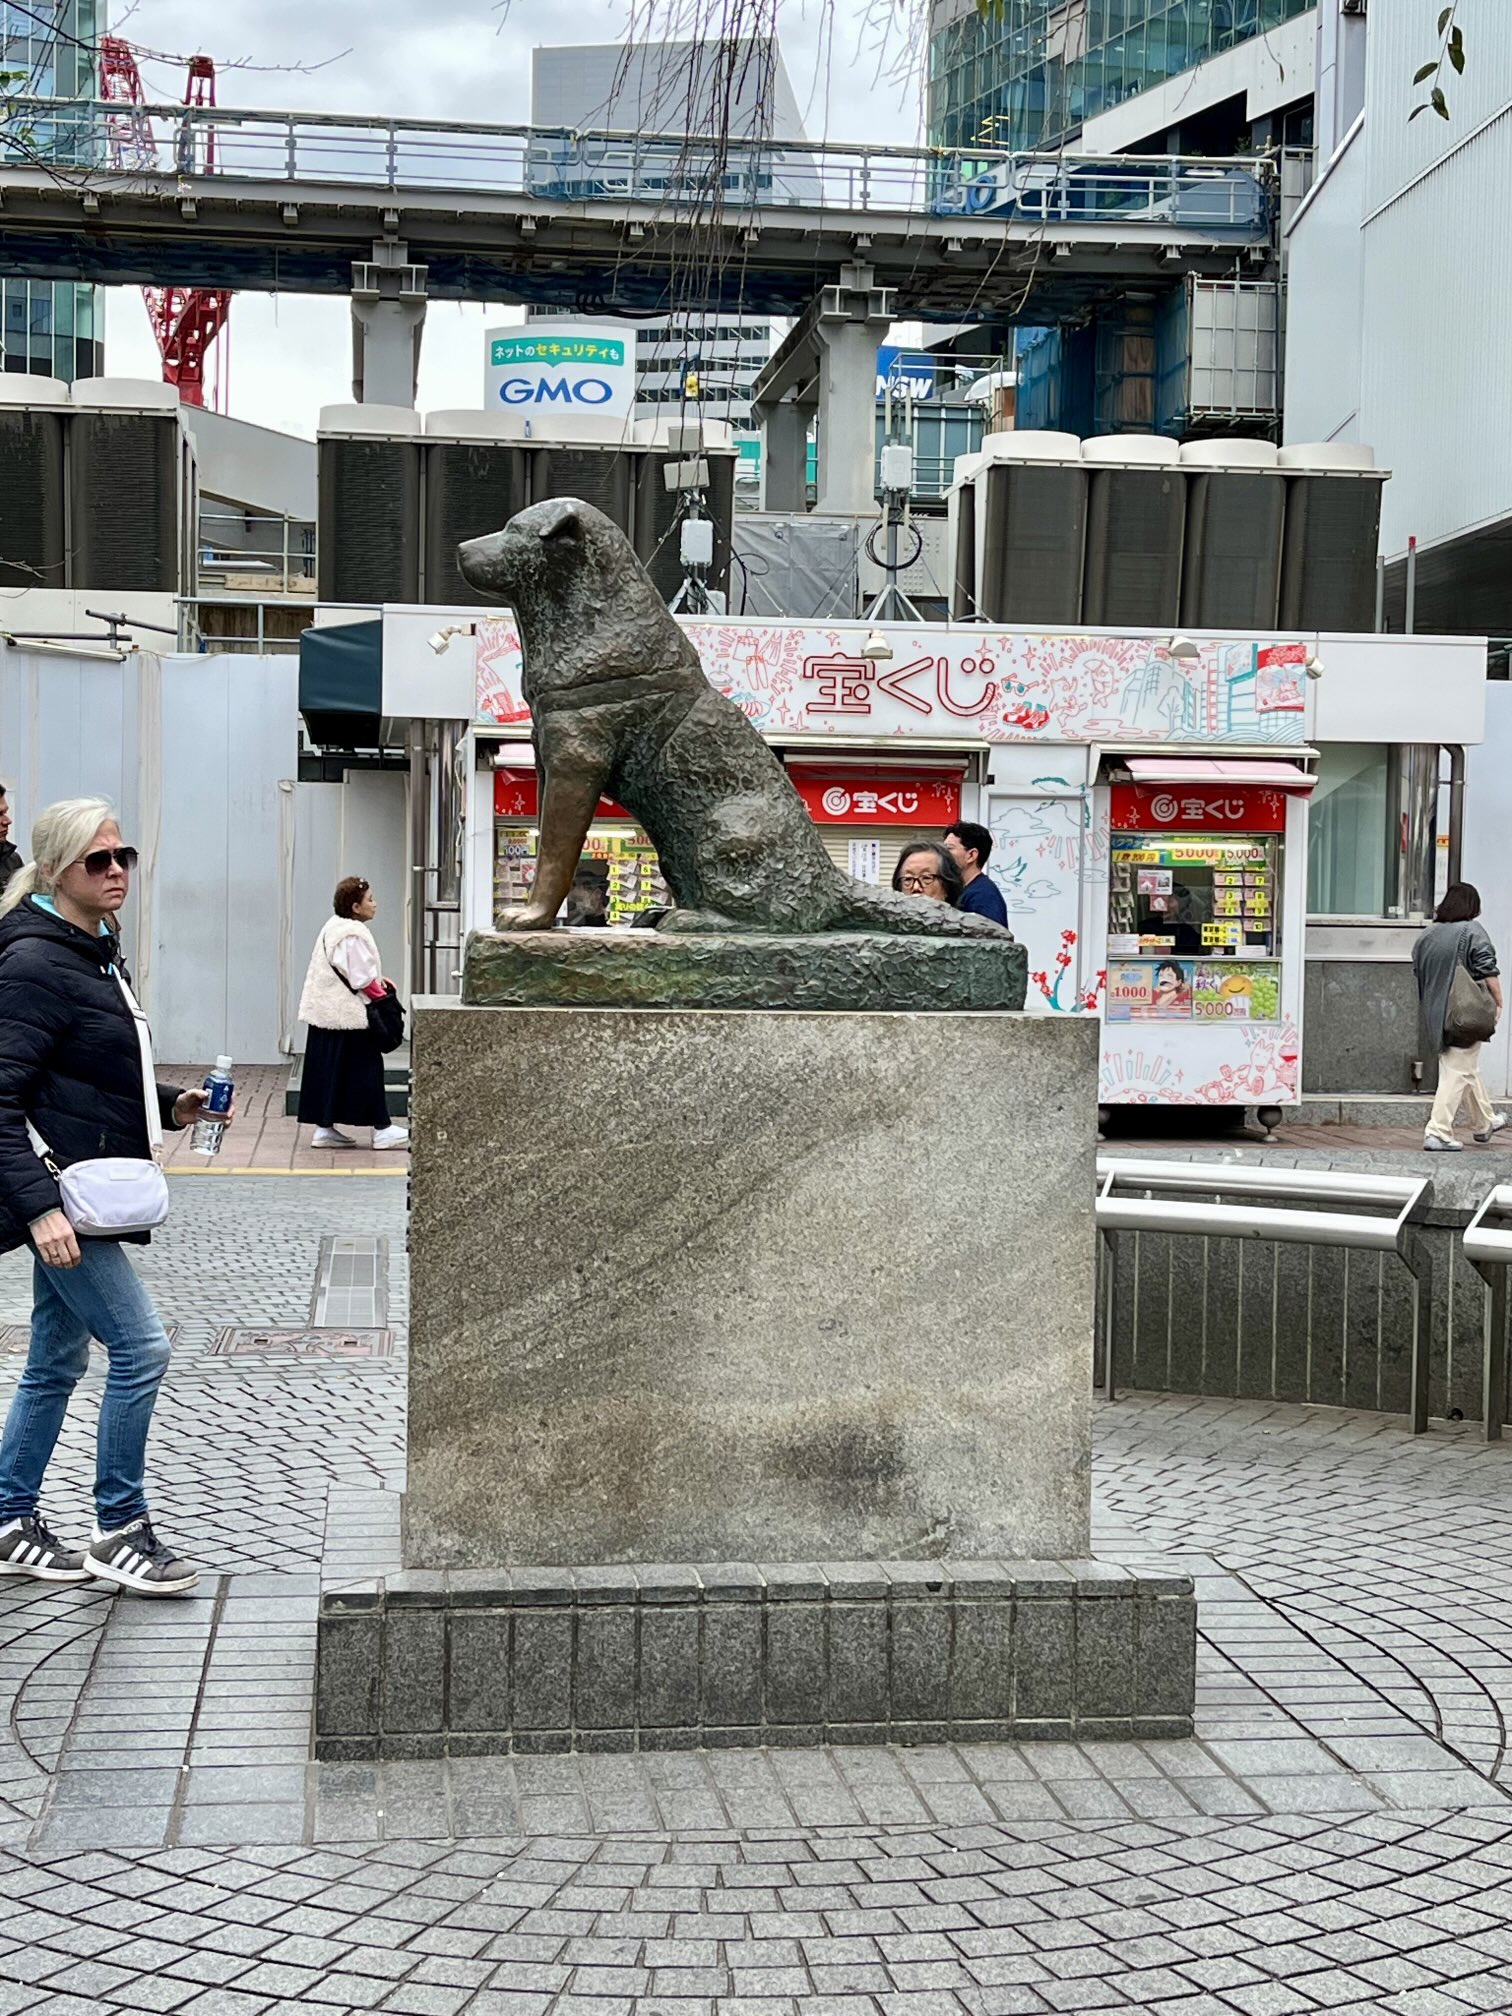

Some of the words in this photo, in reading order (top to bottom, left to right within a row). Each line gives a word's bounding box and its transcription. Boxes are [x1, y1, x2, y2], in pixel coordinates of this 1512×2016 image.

[495, 343, 620, 360] ネットのセキュリティも
[499, 377, 613, 404] GMO
[874, 374, 933, 399] NSW
[802, 651, 996, 718] 宝くじ
[852, 791, 919, 814] 宝くじ
[1180, 798, 1245, 820] 宝くじ
